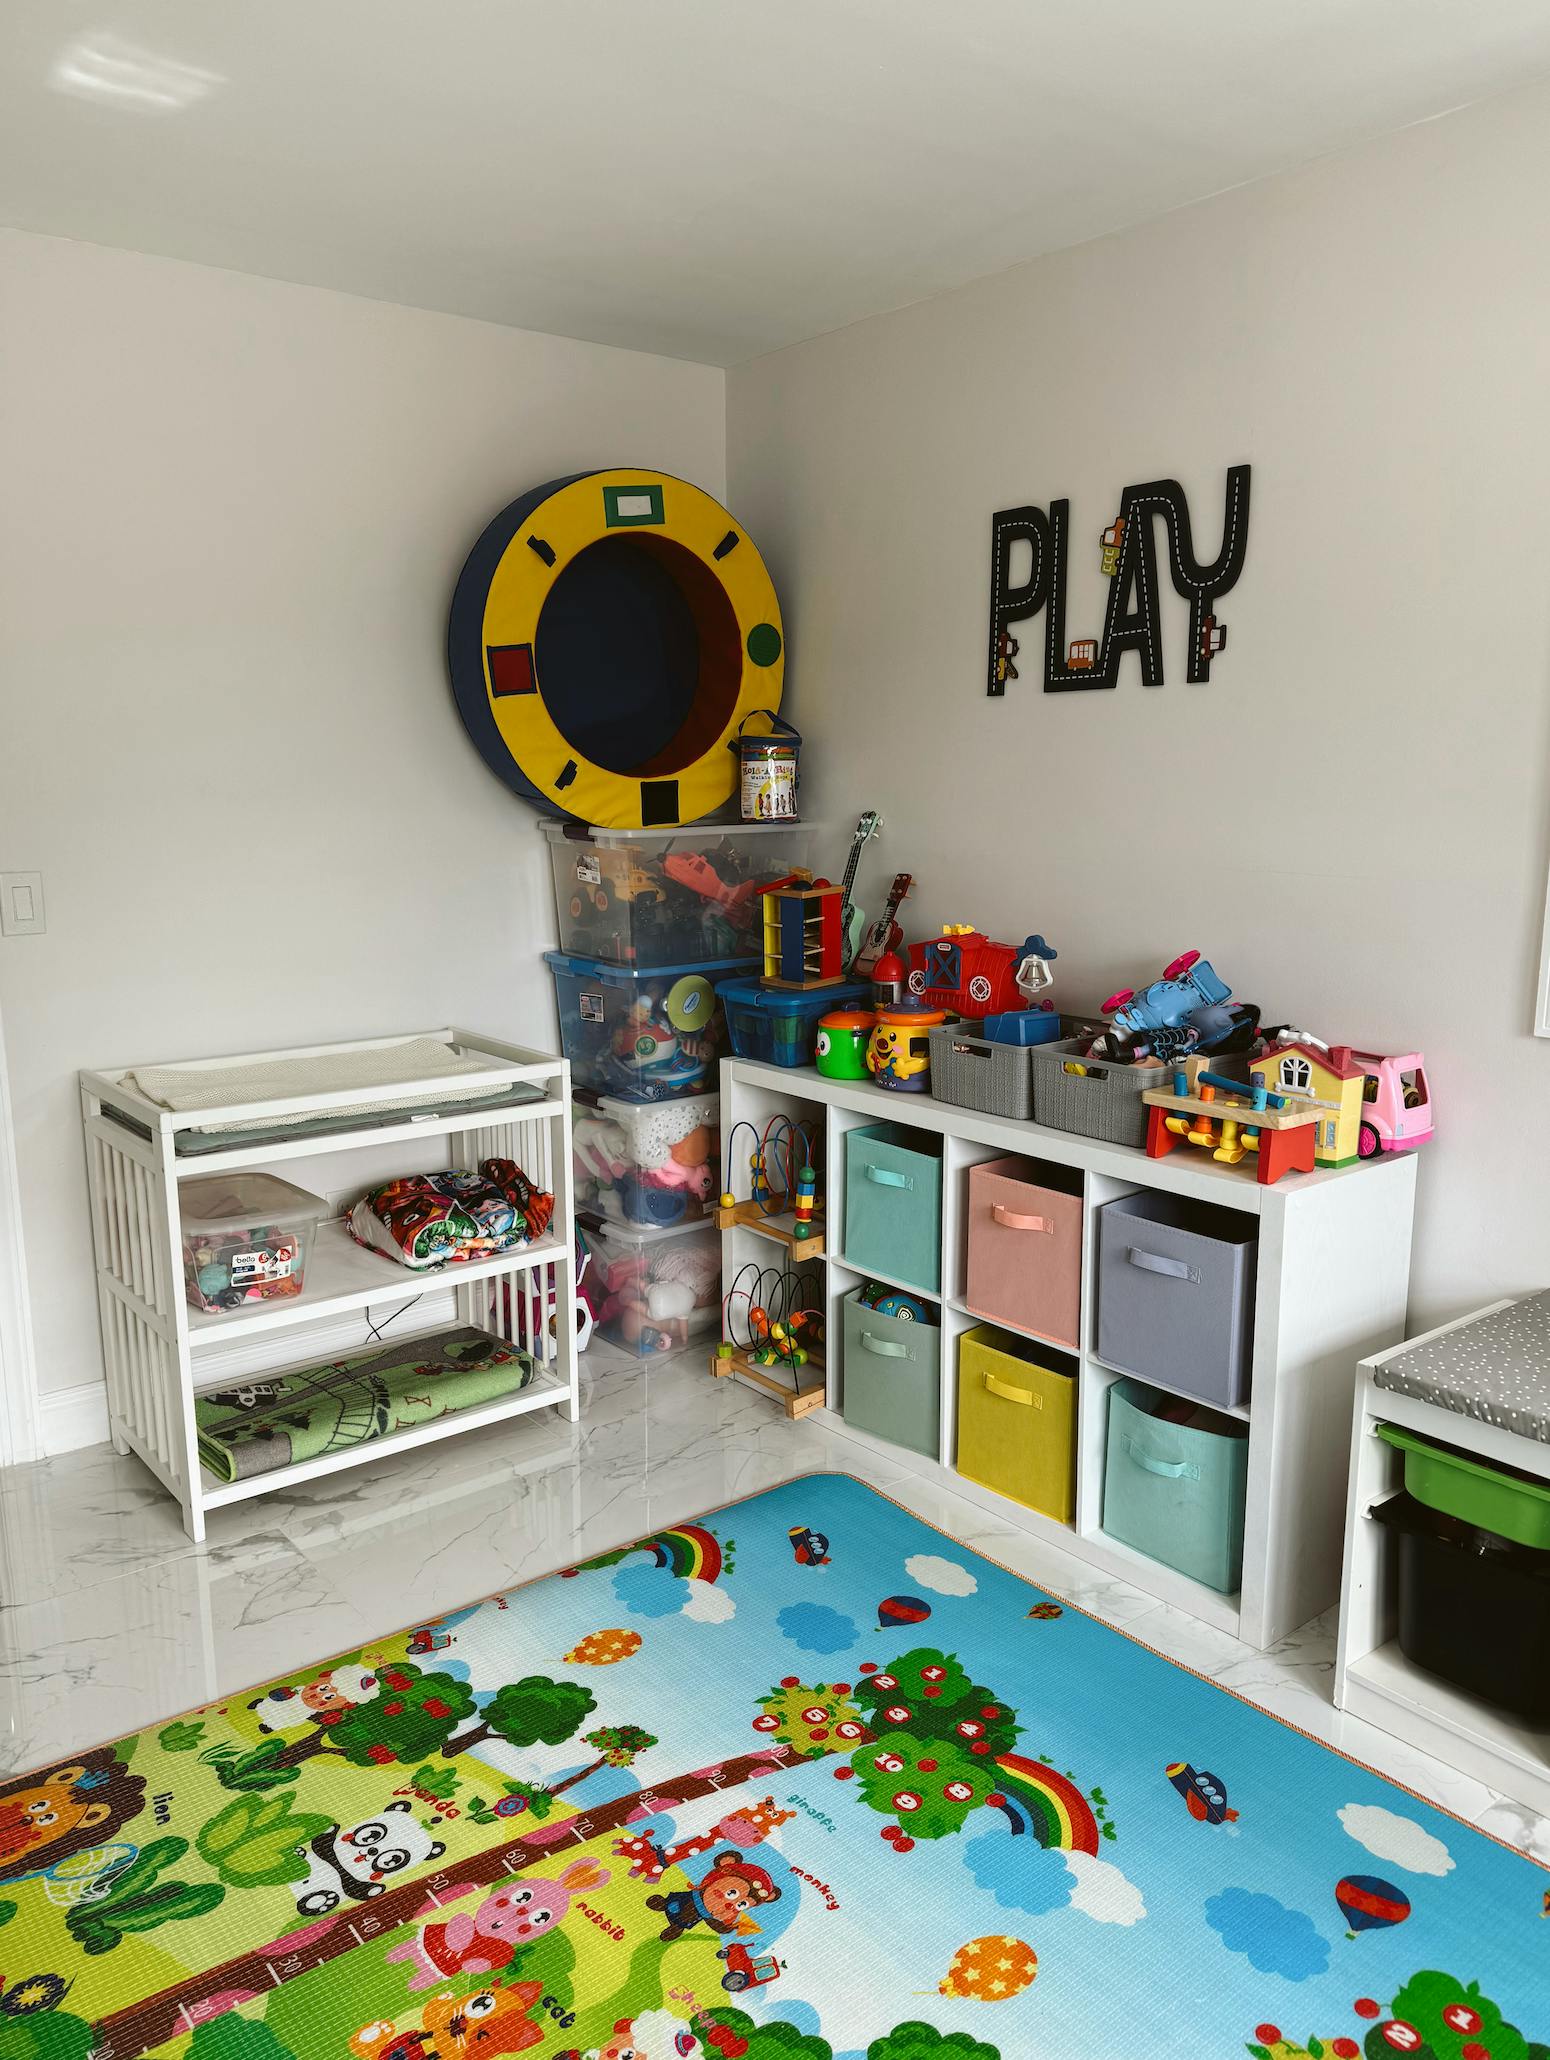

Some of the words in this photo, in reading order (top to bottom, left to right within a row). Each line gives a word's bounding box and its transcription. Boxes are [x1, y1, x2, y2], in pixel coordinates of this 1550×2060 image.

[987, 464, 1251, 696] PLAY
[875, 1676, 895, 1688] 2
[925, 1668, 942, 1679] 1
[805, 1709, 827, 1722] 5
[889, 1708, 909, 1720] 3
[758, 1718, 778, 1730] 7
[840, 1724, 861, 1738] 6
[960, 1722, 981, 1736] 4
[874, 1752, 904, 1773] 10
[710, 1769, 727, 1783] 90
[638, 1791, 659, 1806] 80
[948, 1784, 972, 1799] 8
[152, 1791, 174, 1826] lion
[896, 1795, 918, 1809] 9
[786, 1794, 836, 1832] giraffe
[575, 1818, 594, 1834] 70
[505, 1848, 526, 1865] 60
[427, 1873, 450, 1891] 50
[790, 1866, 840, 1911] monkey
[360, 1915, 381, 1934] 40
[576, 1901, 626, 1941] rabbit
[278, 1954, 303, 1973] 30
[189, 1998, 214, 2018] 20
[542, 1996, 576, 2029] cat
[1449, 2008, 1474, 2030] 1
[1386, 2023, 1417, 2049] 2
